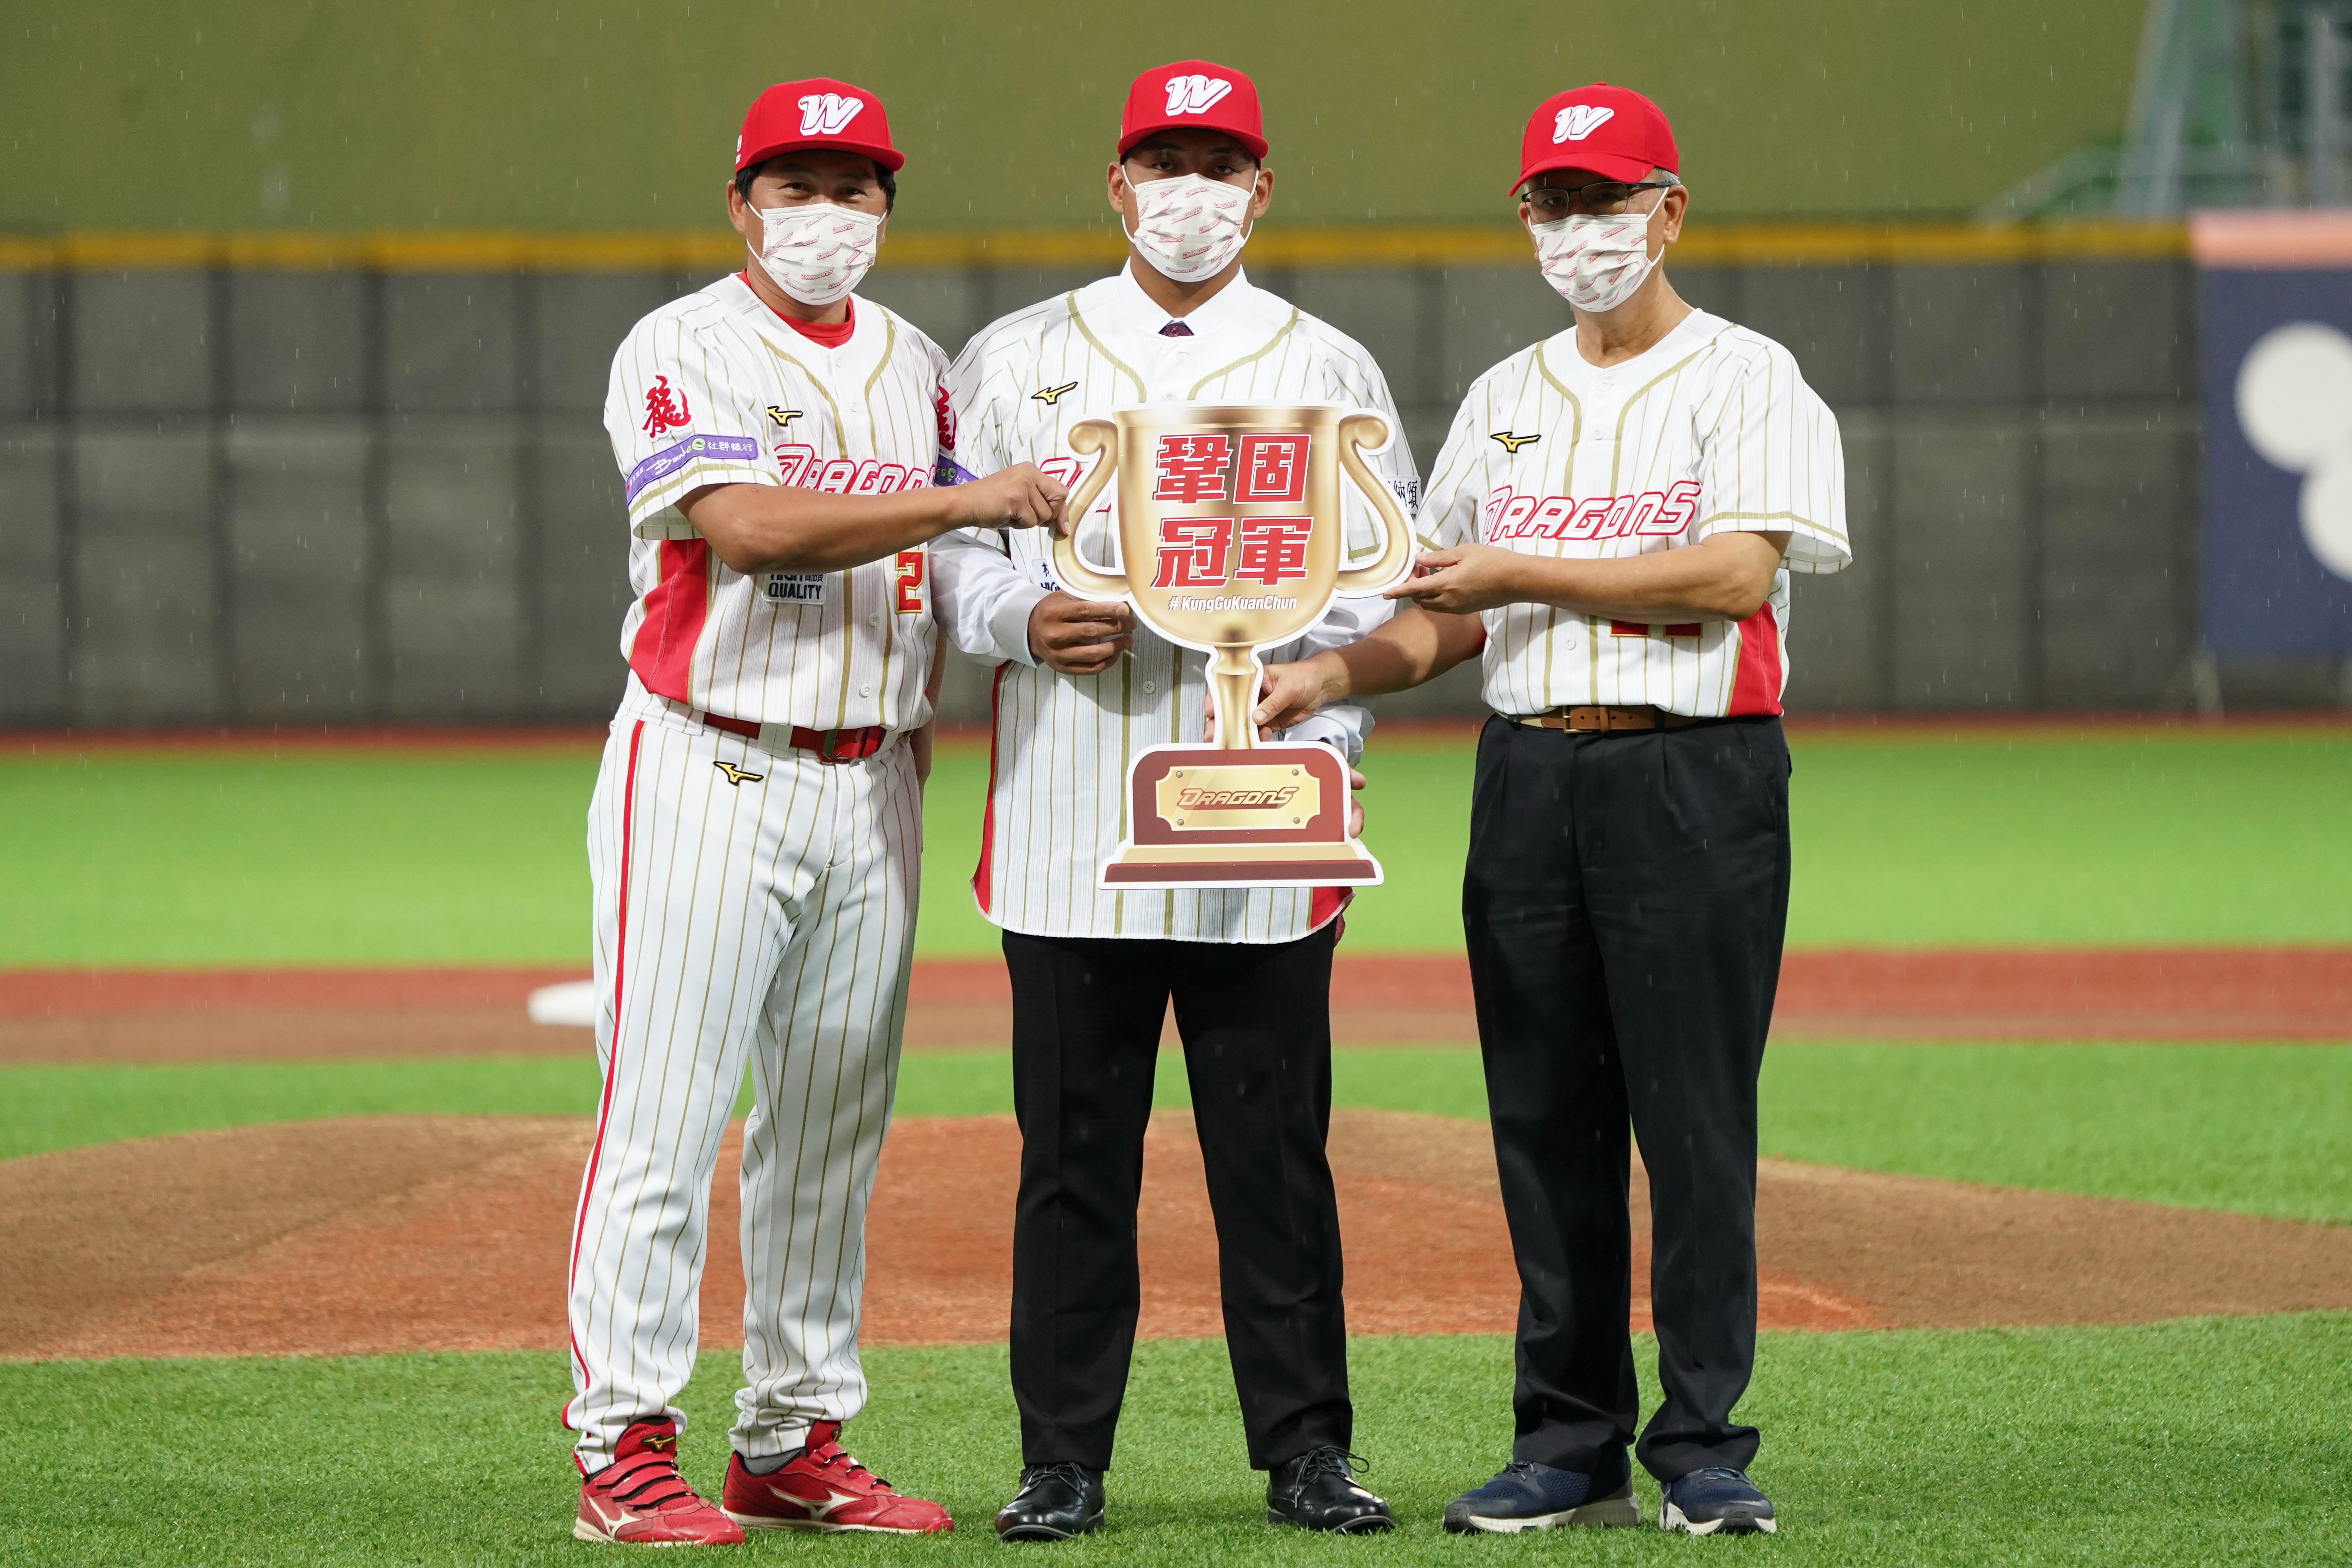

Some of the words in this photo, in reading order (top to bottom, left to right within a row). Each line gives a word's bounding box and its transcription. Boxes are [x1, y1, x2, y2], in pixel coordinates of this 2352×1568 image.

[801, 267, 834, 280] DRAGONS
[707, 441, 753, 452] 社群銀行
[1152, 433, 1312, 505] 鞏固
[1482, 480, 1700, 544] DRAGONS
[1150, 515, 1314, 589] 冠軍
[768, 582, 822, 600] QUALITY
[1177, 787, 1299, 810] DRAGONS
